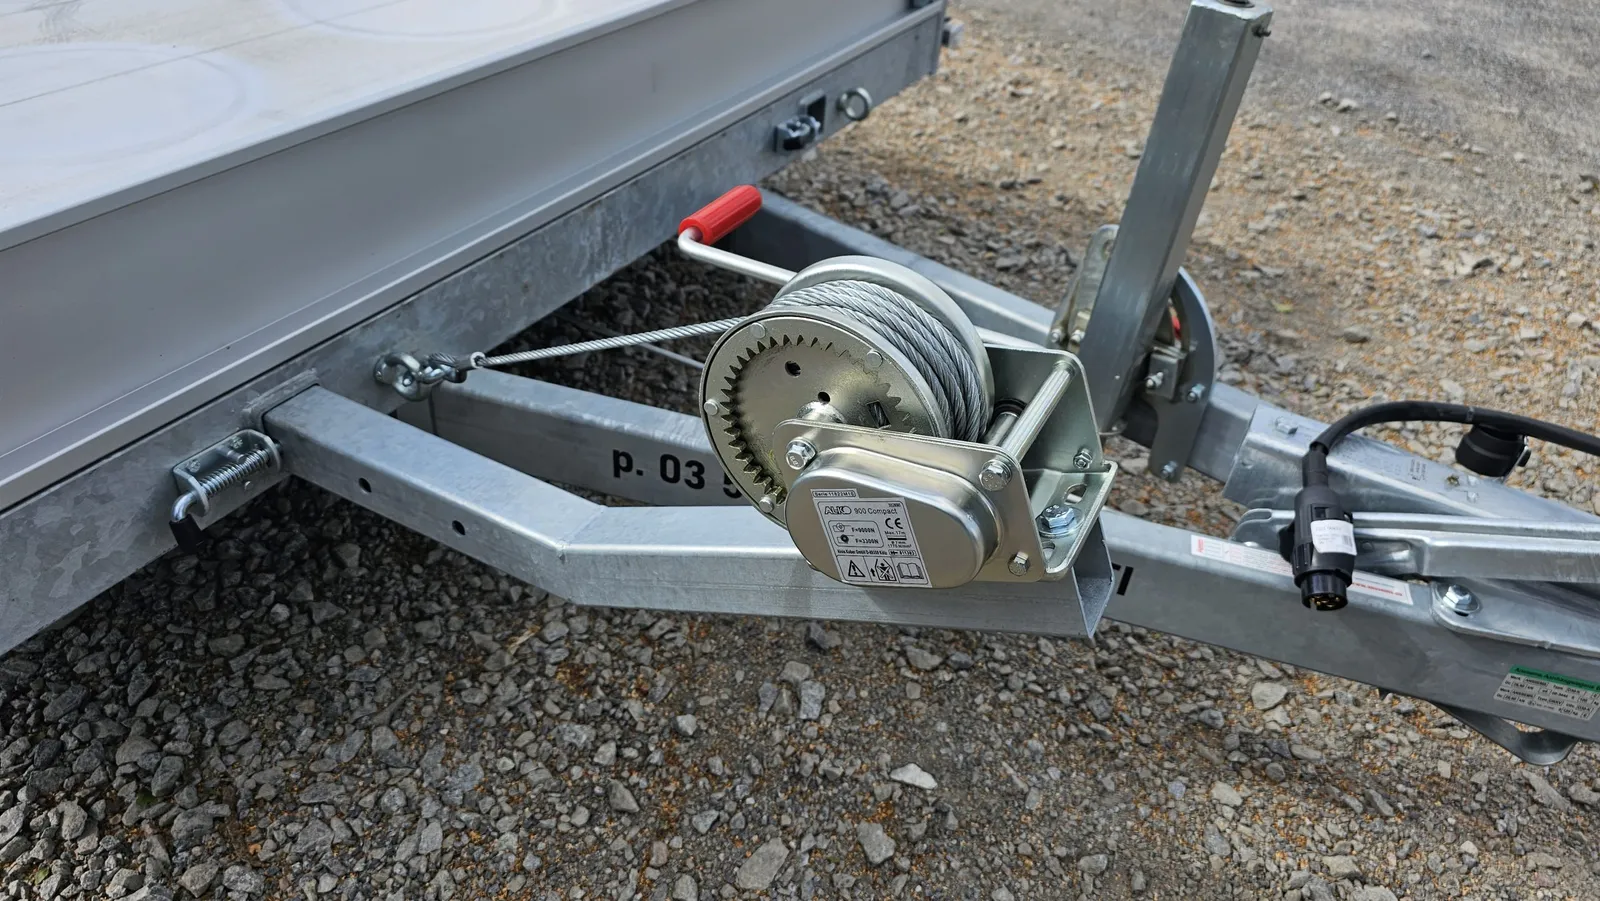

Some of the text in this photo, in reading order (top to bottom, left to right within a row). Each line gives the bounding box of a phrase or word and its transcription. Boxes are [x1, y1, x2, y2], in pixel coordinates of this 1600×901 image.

[612, 449, 644, 479] p.
[659, 453, 706, 490] 03
[867, 507, 898, 516] Compact
